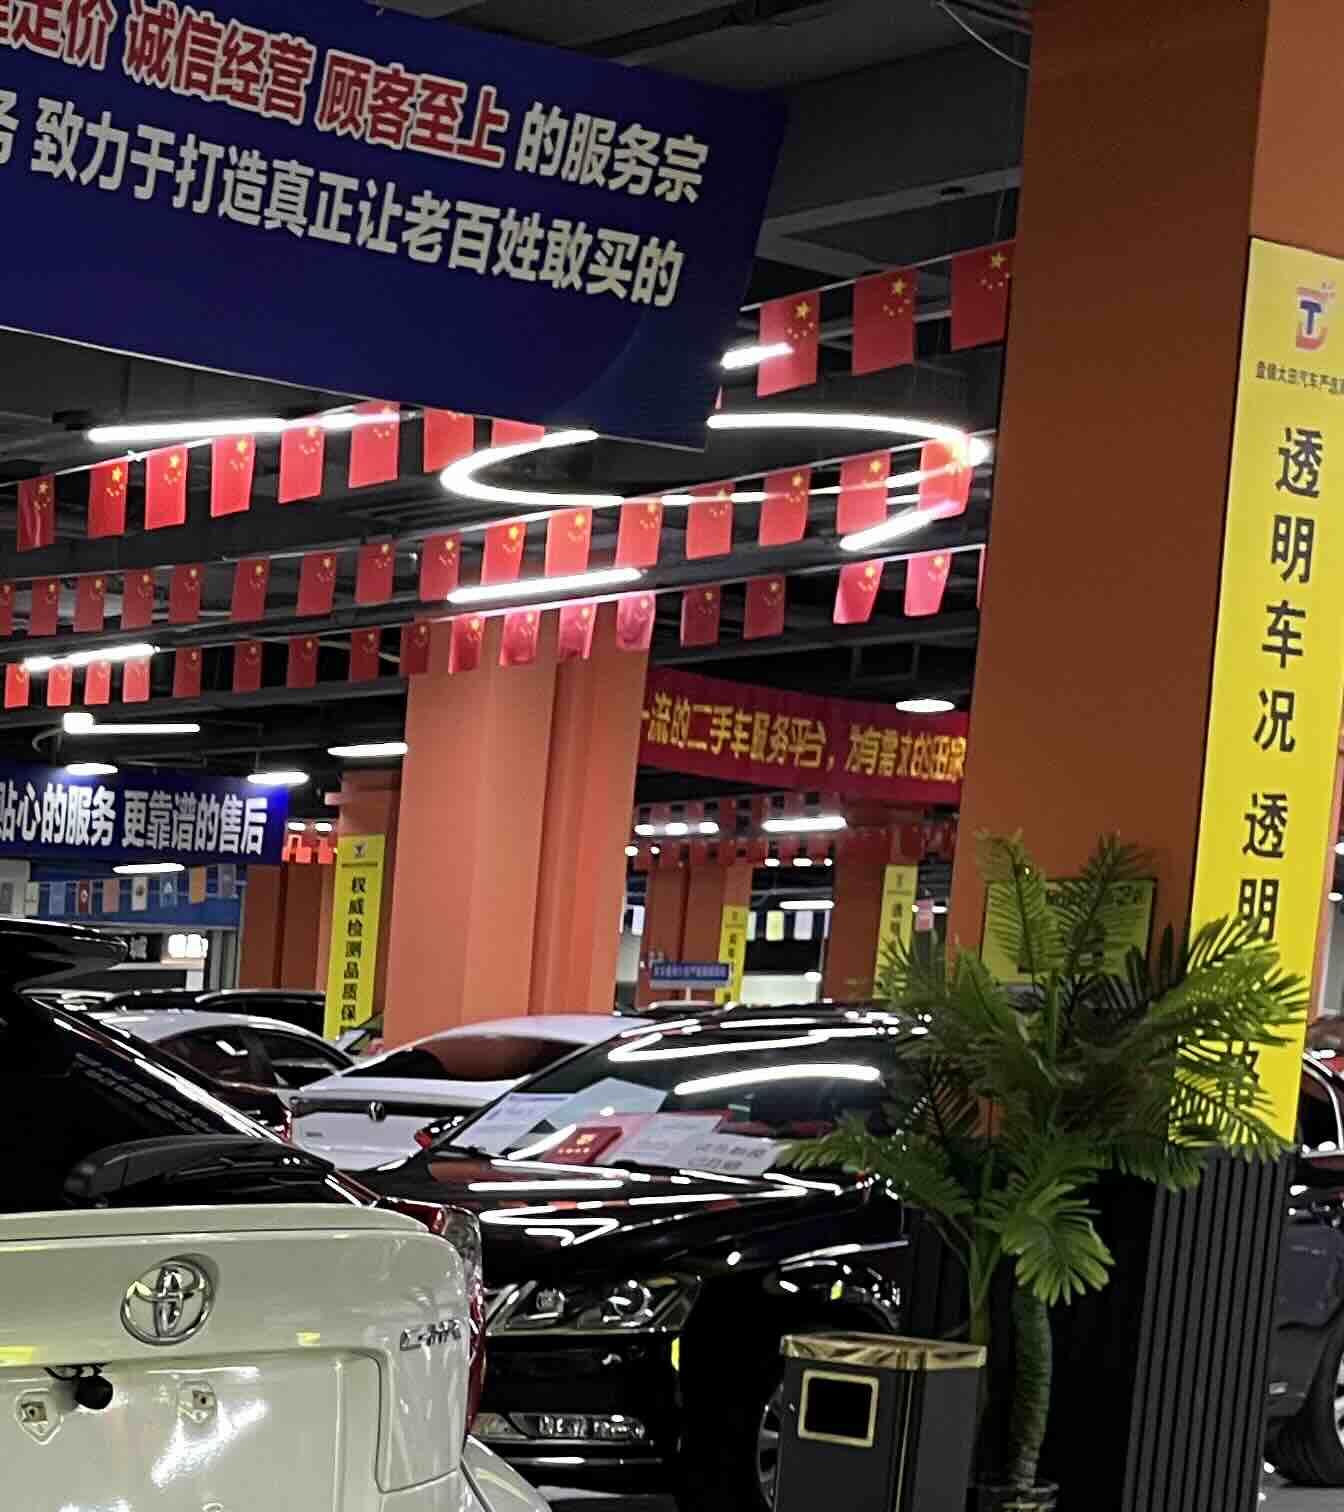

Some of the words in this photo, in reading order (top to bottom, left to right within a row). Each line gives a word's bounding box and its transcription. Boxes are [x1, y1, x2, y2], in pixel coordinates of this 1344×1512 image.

[30, 95, 684, 308] 致力于打造真正让老百姓敢买的
[123, 0, 316, 126] 诚信经营
[316, 48, 512, 169] 顾客至上
[515, 101, 709, 203] 的服务宗
[1252, 425, 1324, 754] 透明车况
[122, 788, 268, 856] 更靠谱的售后
